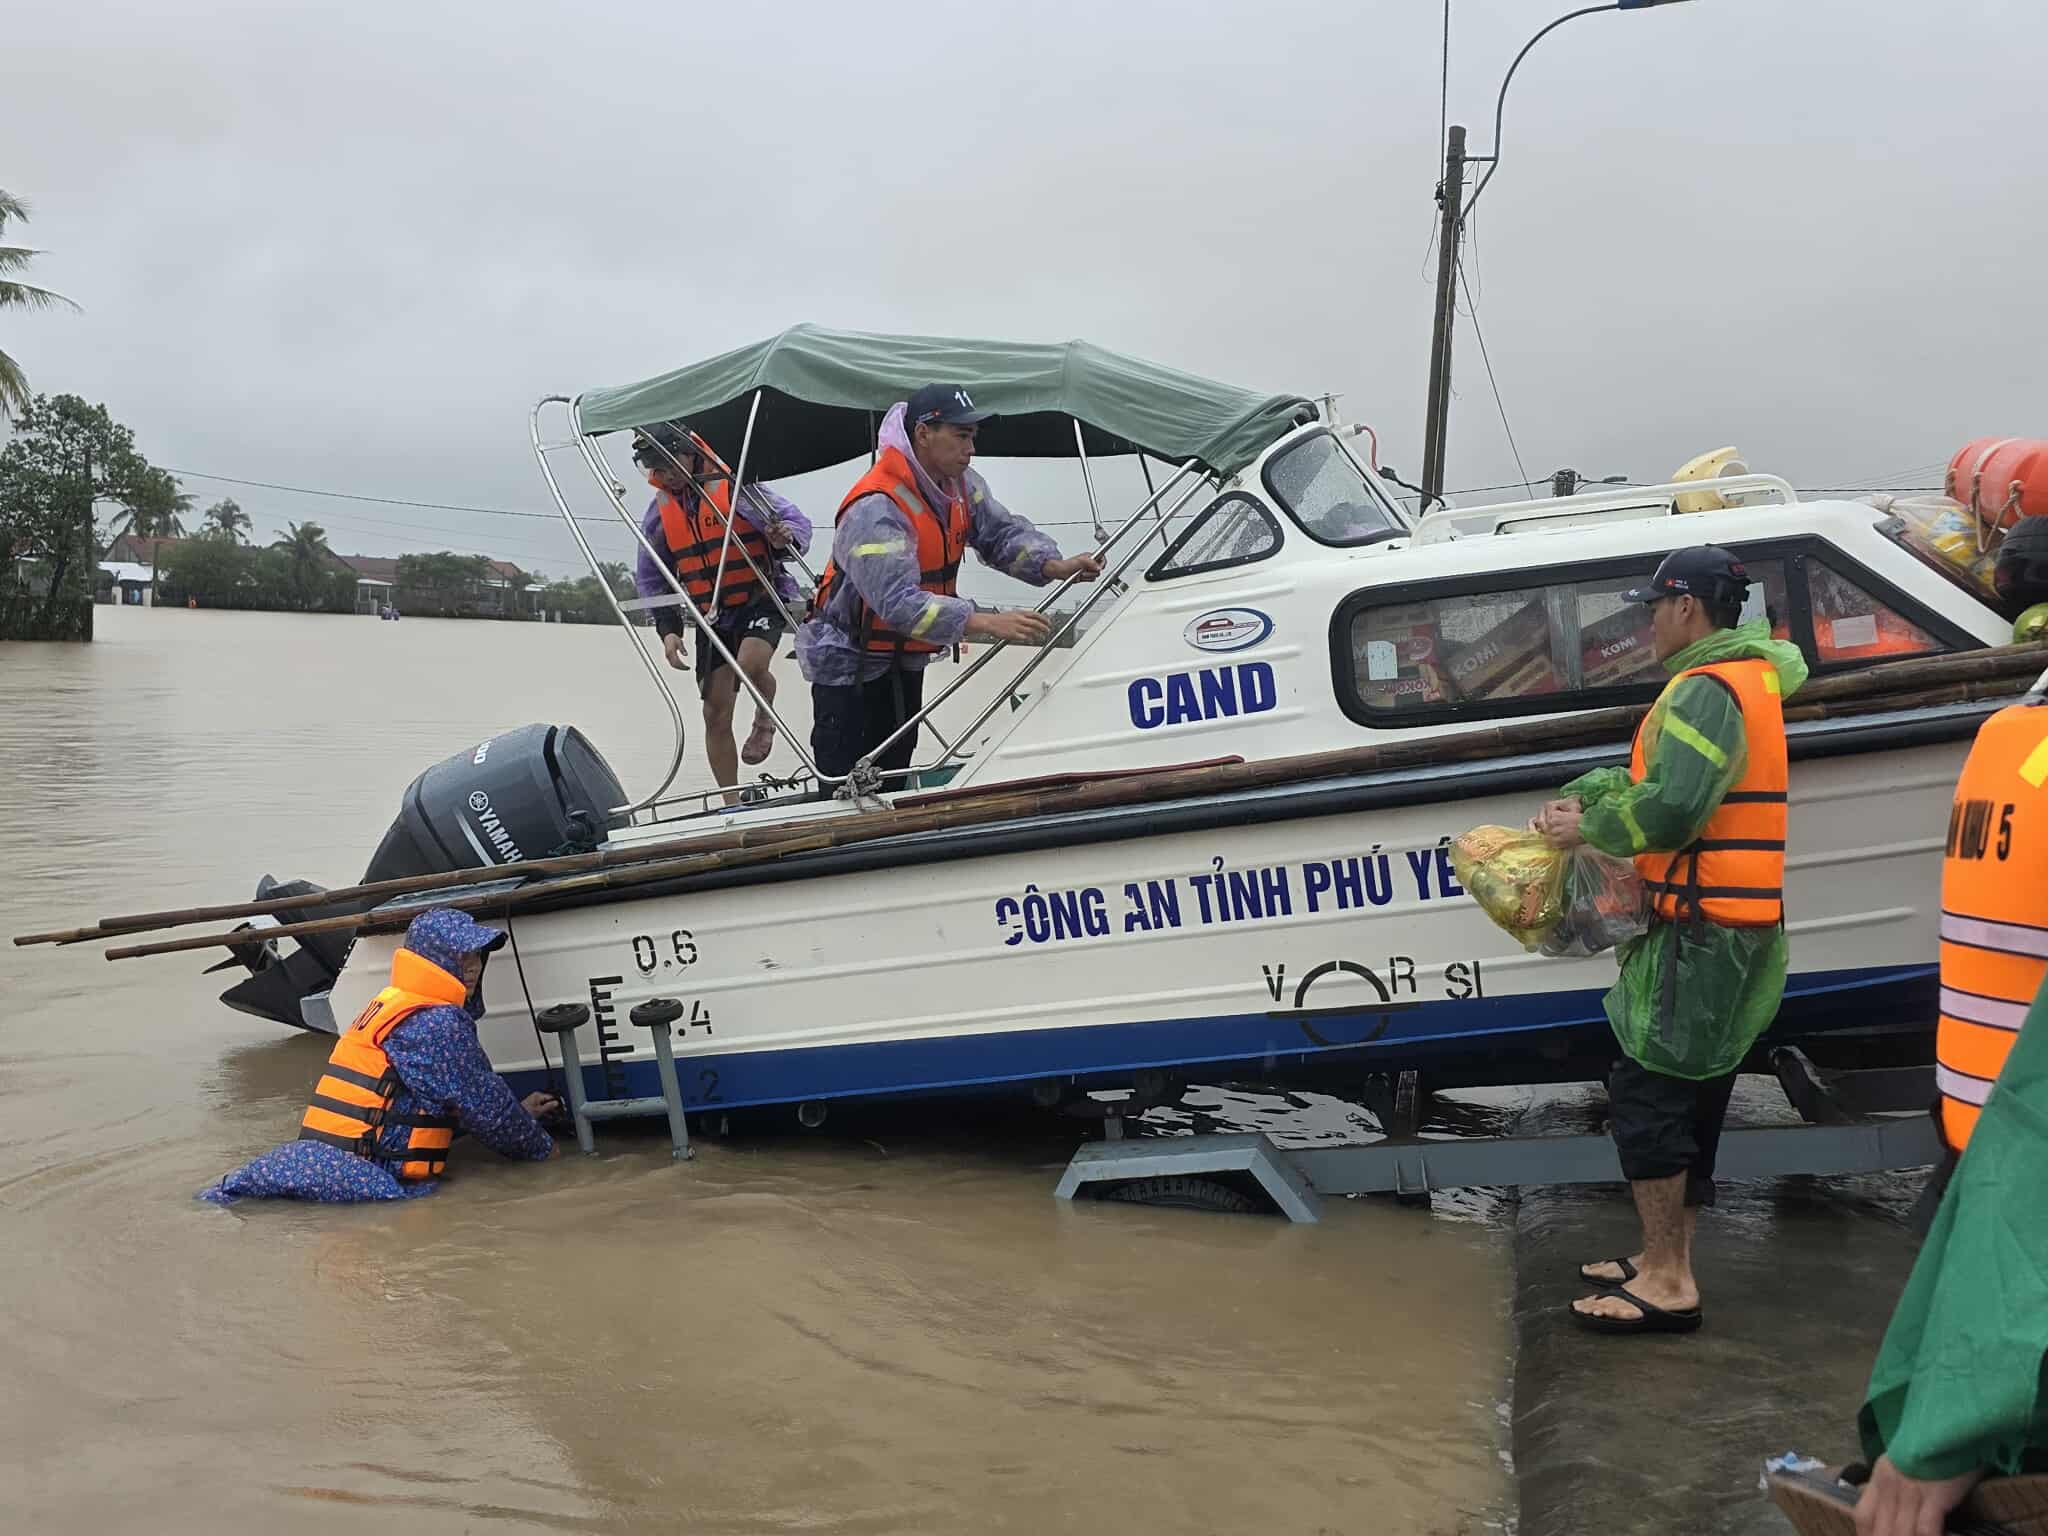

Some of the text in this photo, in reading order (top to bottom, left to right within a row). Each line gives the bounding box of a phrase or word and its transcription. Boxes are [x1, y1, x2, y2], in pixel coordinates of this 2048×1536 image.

[1128, 662, 1276, 729] CAND
[478, 807, 524, 864] YAMAH
[1996, 803, 2016, 862] 5
[995, 836, 1470, 946] CÔNG AN TỈNH PHÚ YÊ
[632, 929, 698, 973] 0.6
